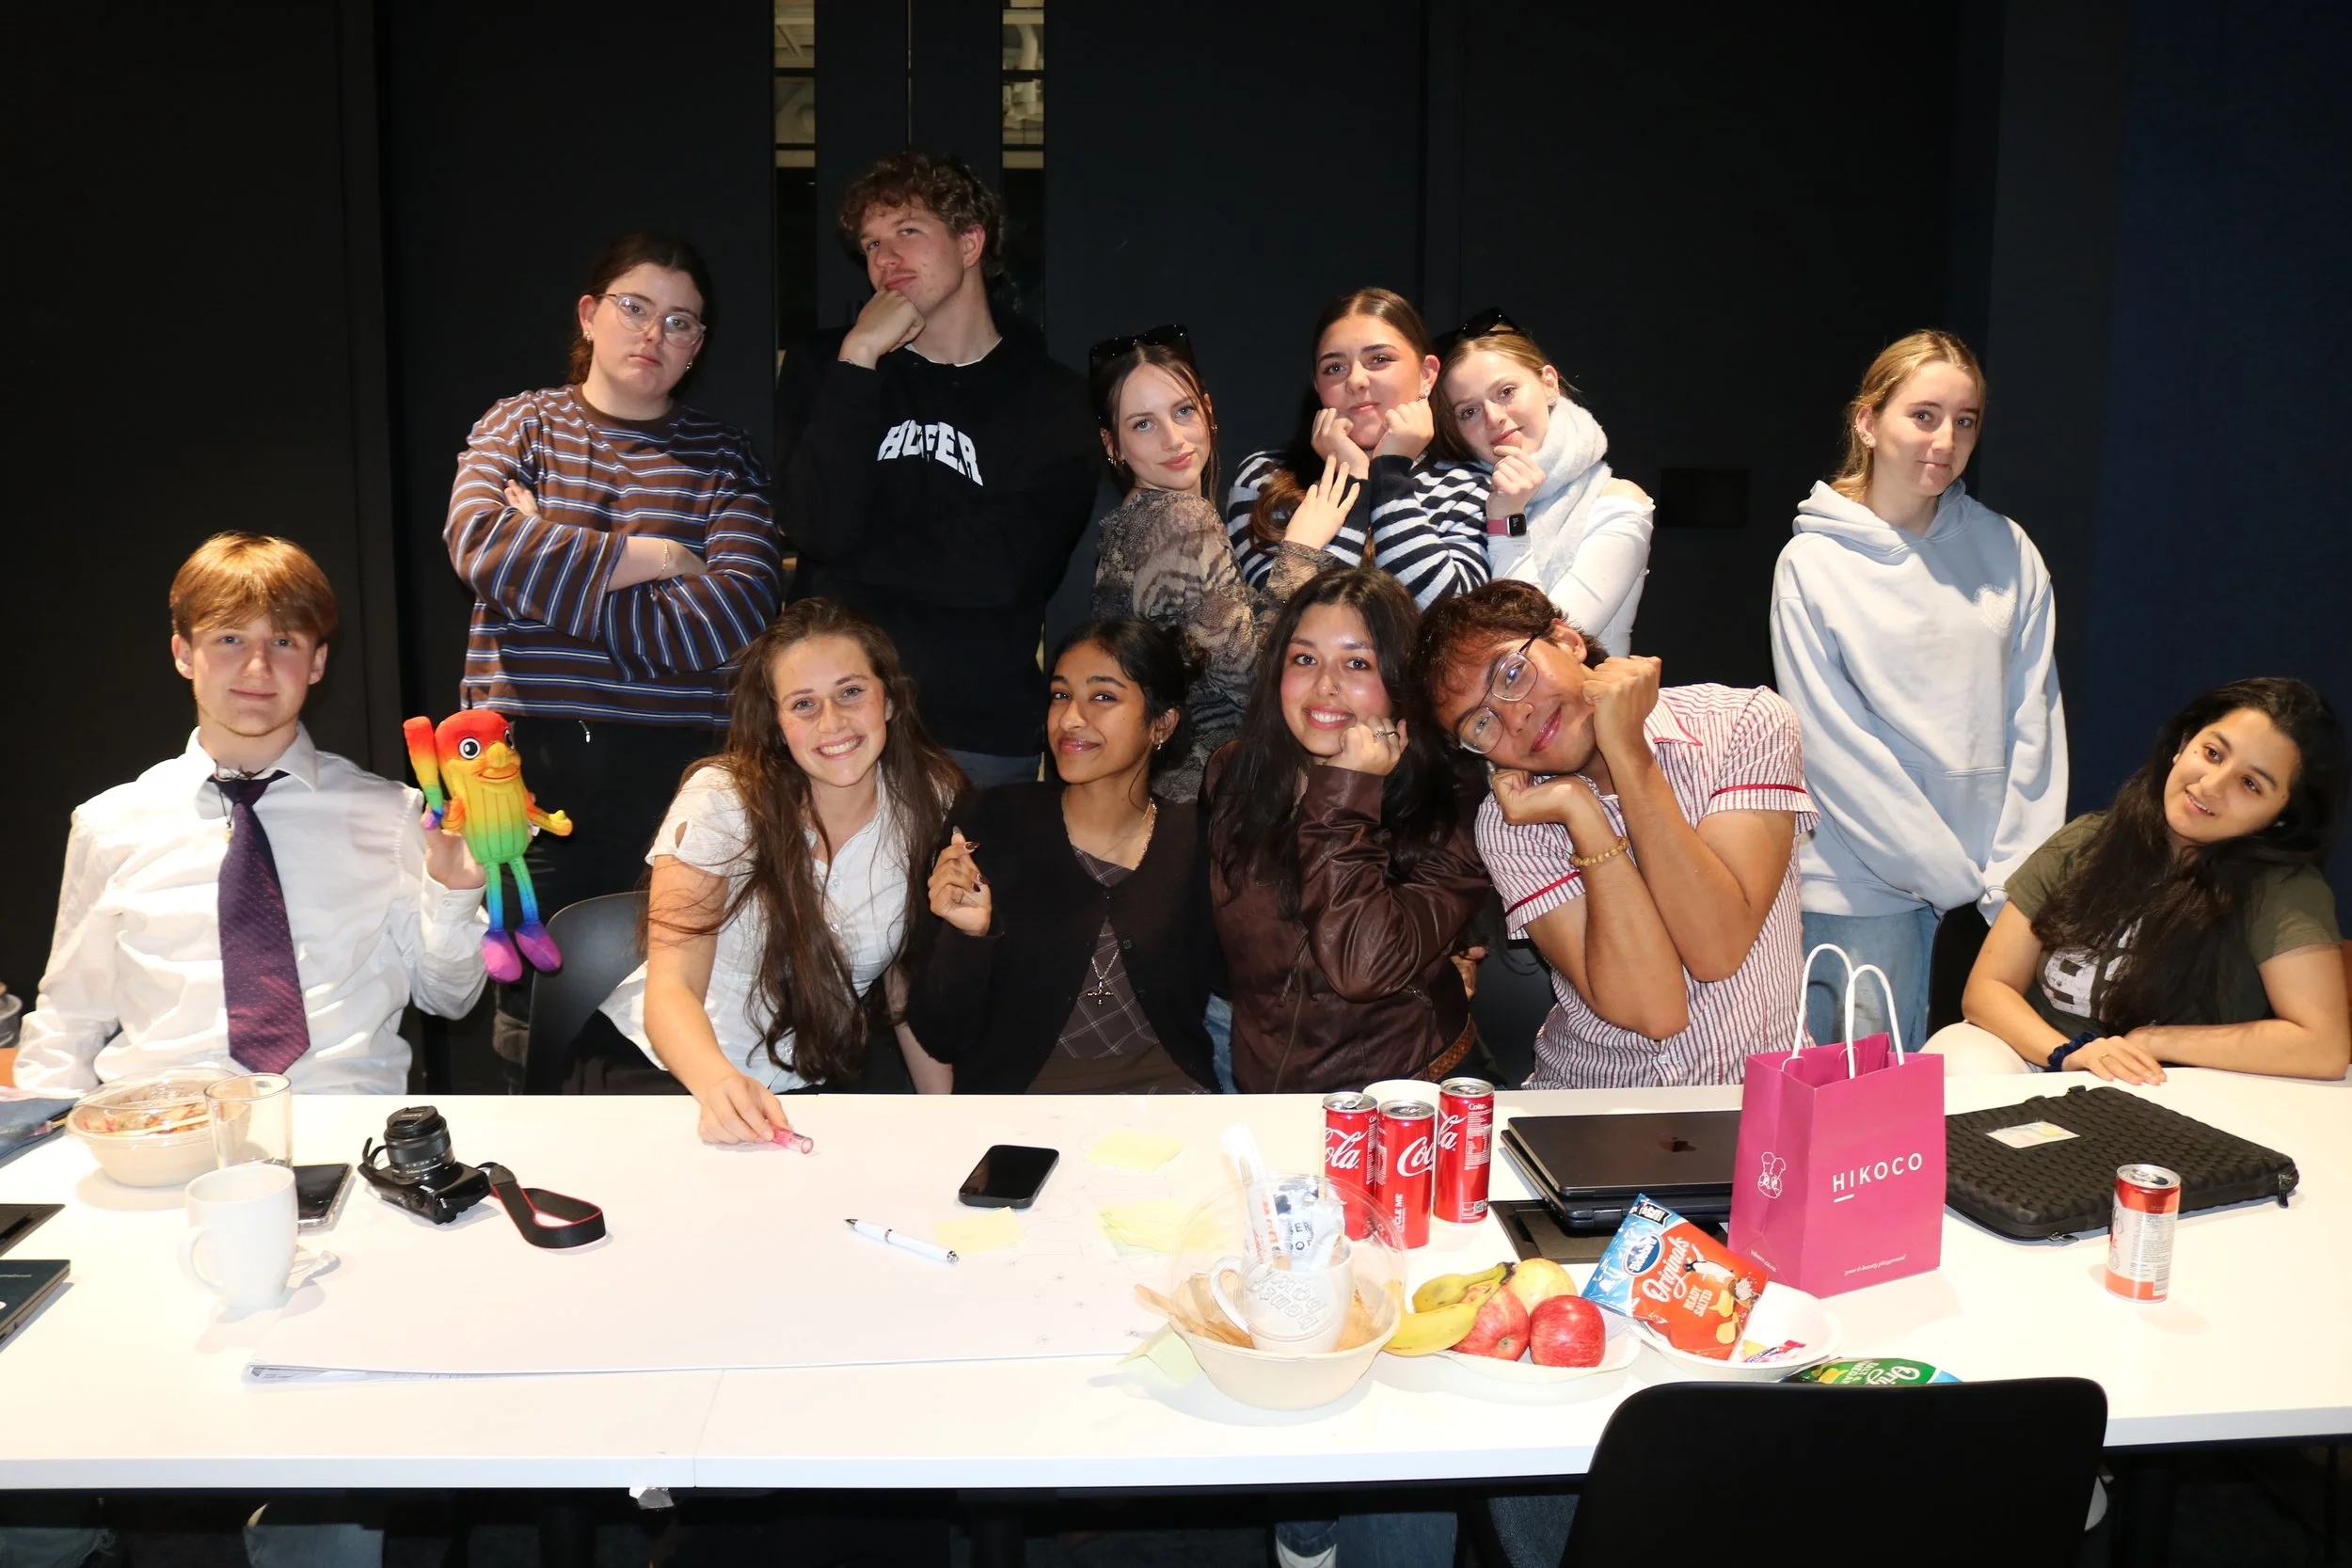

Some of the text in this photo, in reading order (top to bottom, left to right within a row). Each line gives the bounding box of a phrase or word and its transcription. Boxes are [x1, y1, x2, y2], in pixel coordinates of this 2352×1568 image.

[1833, 1152, 1923, 1193] HIKOCO
[1642, 1236, 1692, 1303] Originals
[1683, 1285, 1702, 1311] READY
[1693, 1289, 1713, 1317] SALTED
